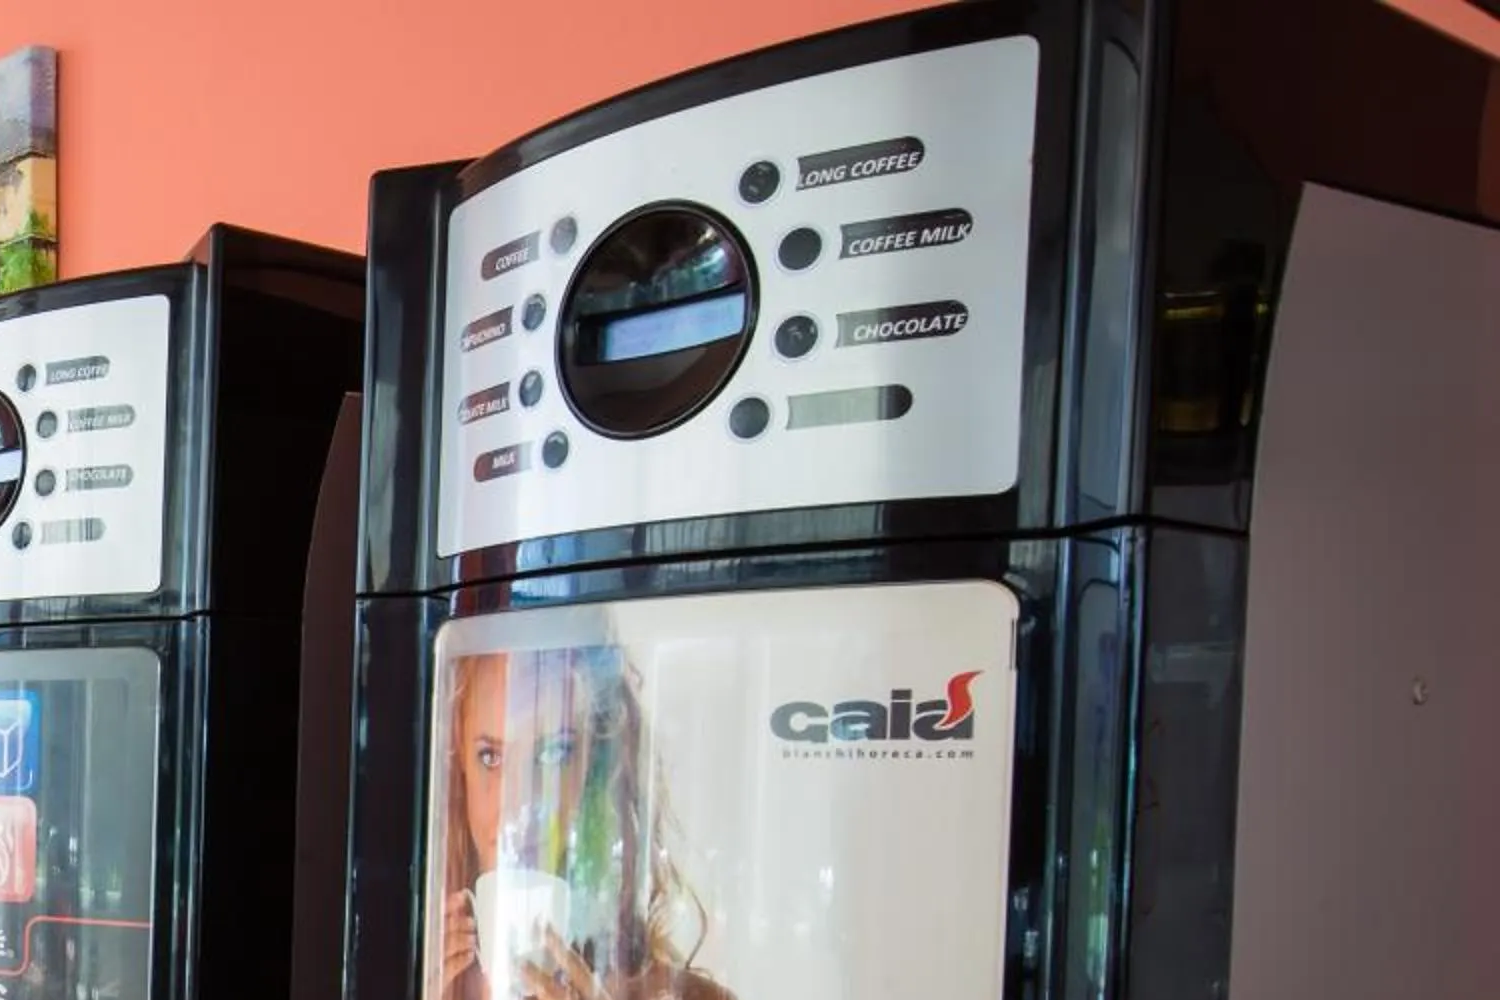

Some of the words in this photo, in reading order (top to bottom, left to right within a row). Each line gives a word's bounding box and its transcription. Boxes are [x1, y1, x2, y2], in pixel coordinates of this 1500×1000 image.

[797, 165, 846, 188] LONG
[851, 151, 920, 178] COFFEE
[848, 231, 916, 255] COFFEE
[919, 223, 972, 244] MILK
[495, 248, 529, 271] COFFEE
[853, 313, 966, 341] CHOCOLATE
